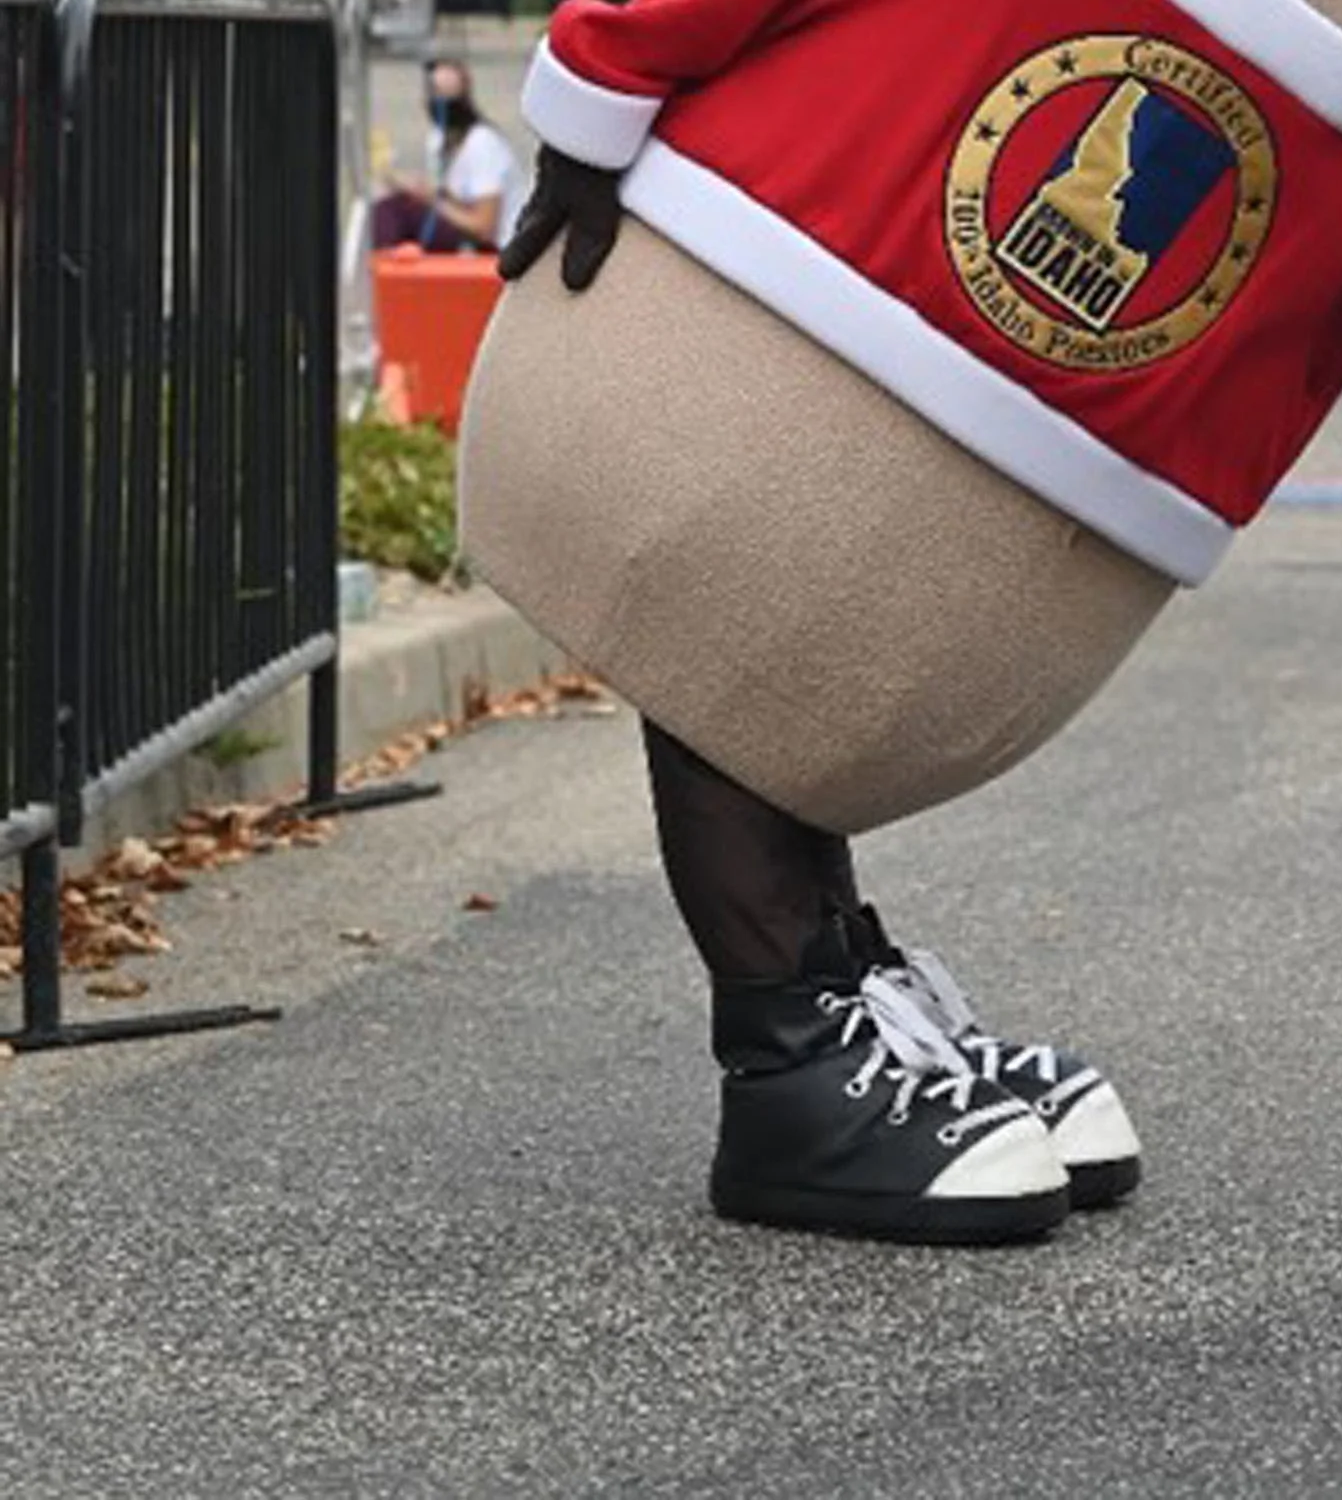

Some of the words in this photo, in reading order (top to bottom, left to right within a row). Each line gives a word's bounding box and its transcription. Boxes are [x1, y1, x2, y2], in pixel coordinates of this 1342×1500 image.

[1124, 40, 1263, 150] Certified
[967, 262, 1034, 341] Idaho
[1005, 218, 1123, 319] IDAHO
